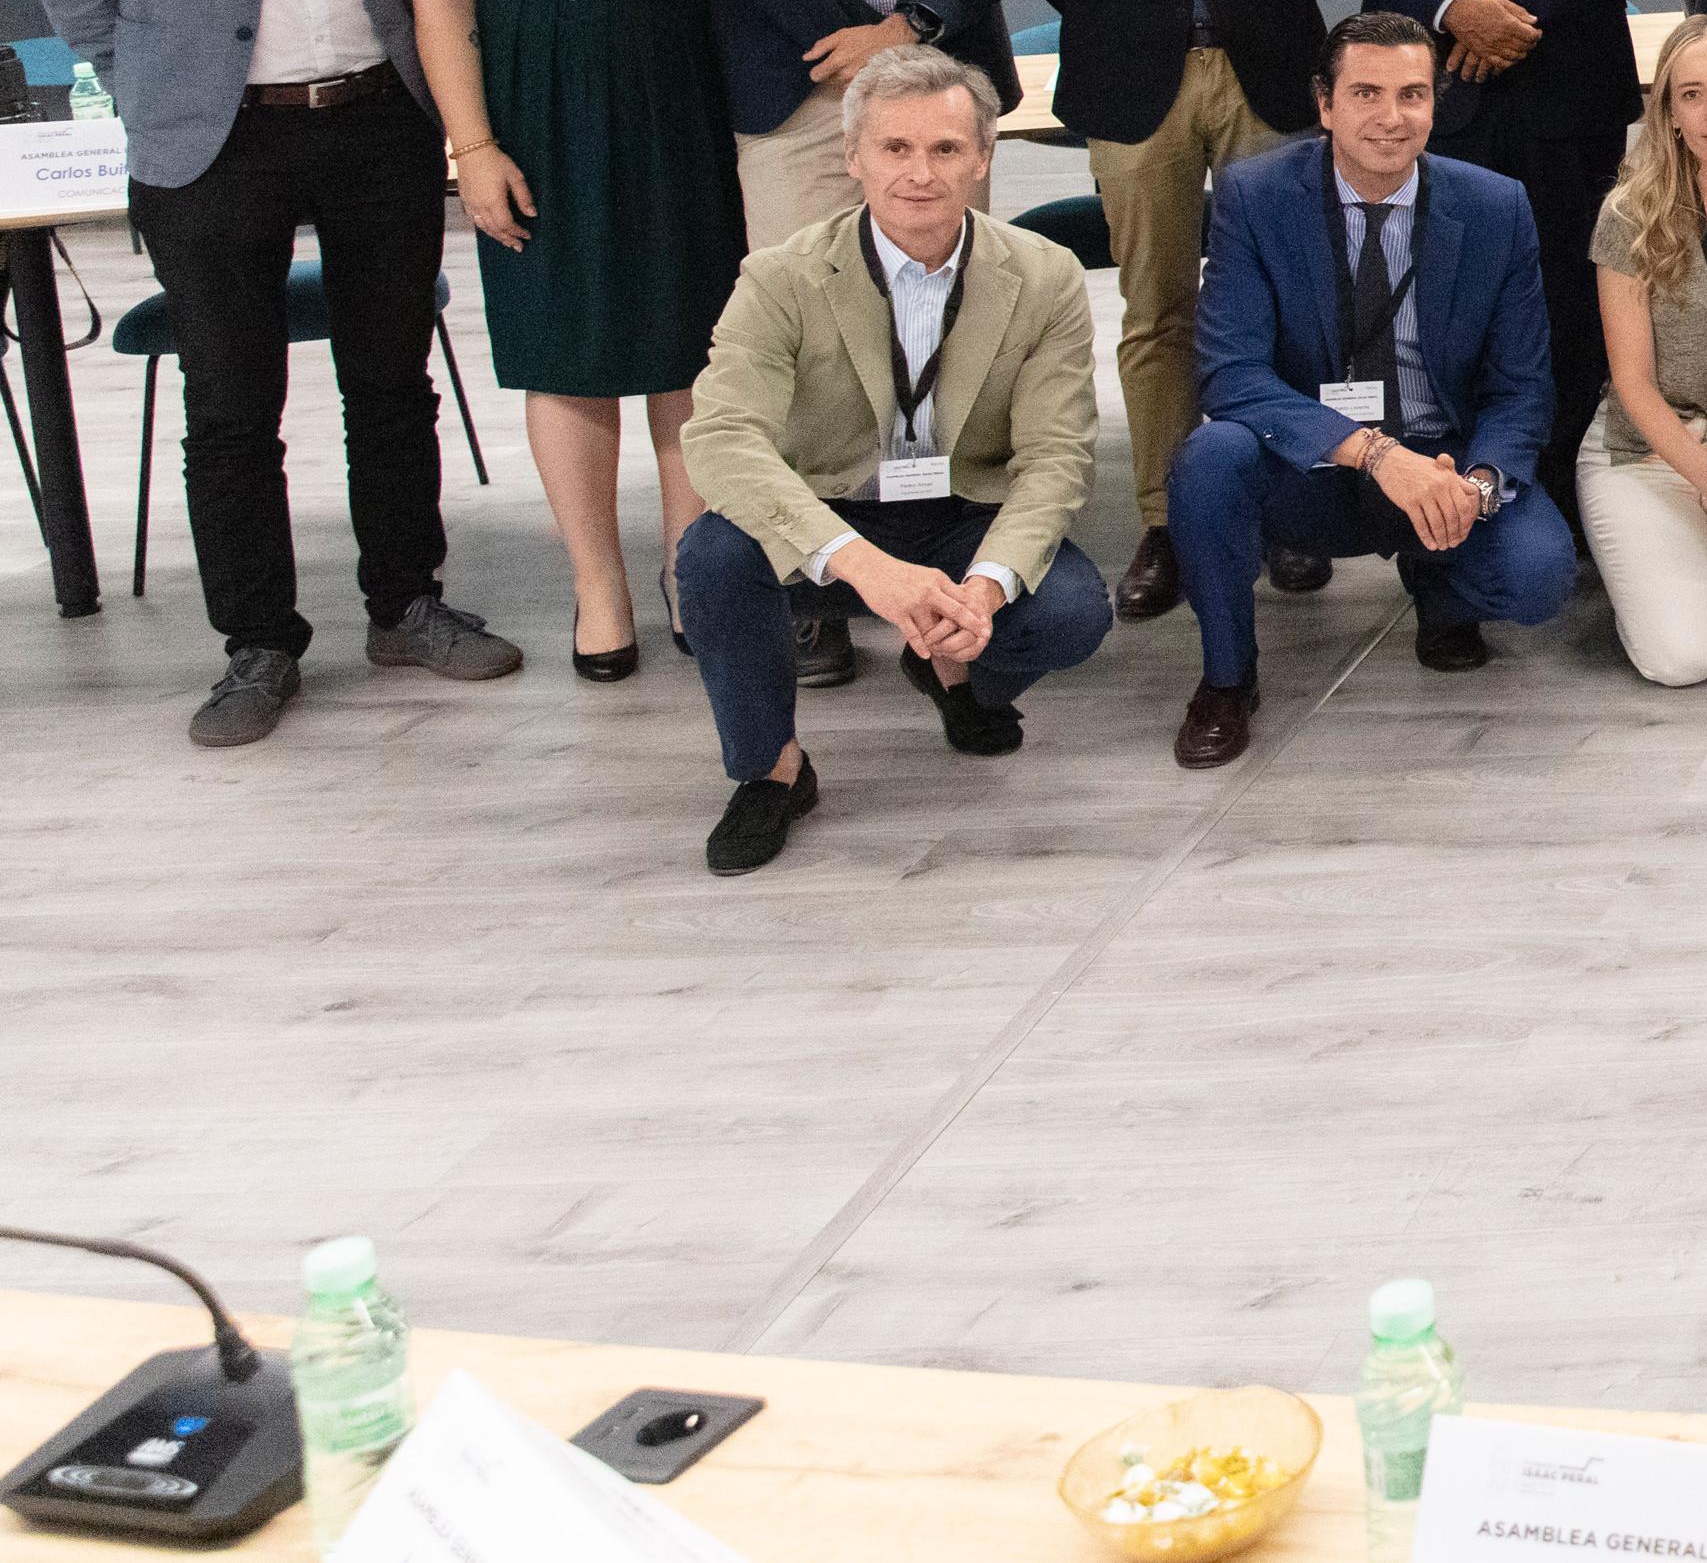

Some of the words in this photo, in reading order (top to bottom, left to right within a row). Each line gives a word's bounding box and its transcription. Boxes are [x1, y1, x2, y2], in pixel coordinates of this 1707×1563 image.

[21, 151, 73, 160] ASAMBLEA
[76, 148, 122, 158] GENERAL
[36, 166, 92, 180] Carlos
[1477, 1520, 1599, 1549] ASAMBLEA
